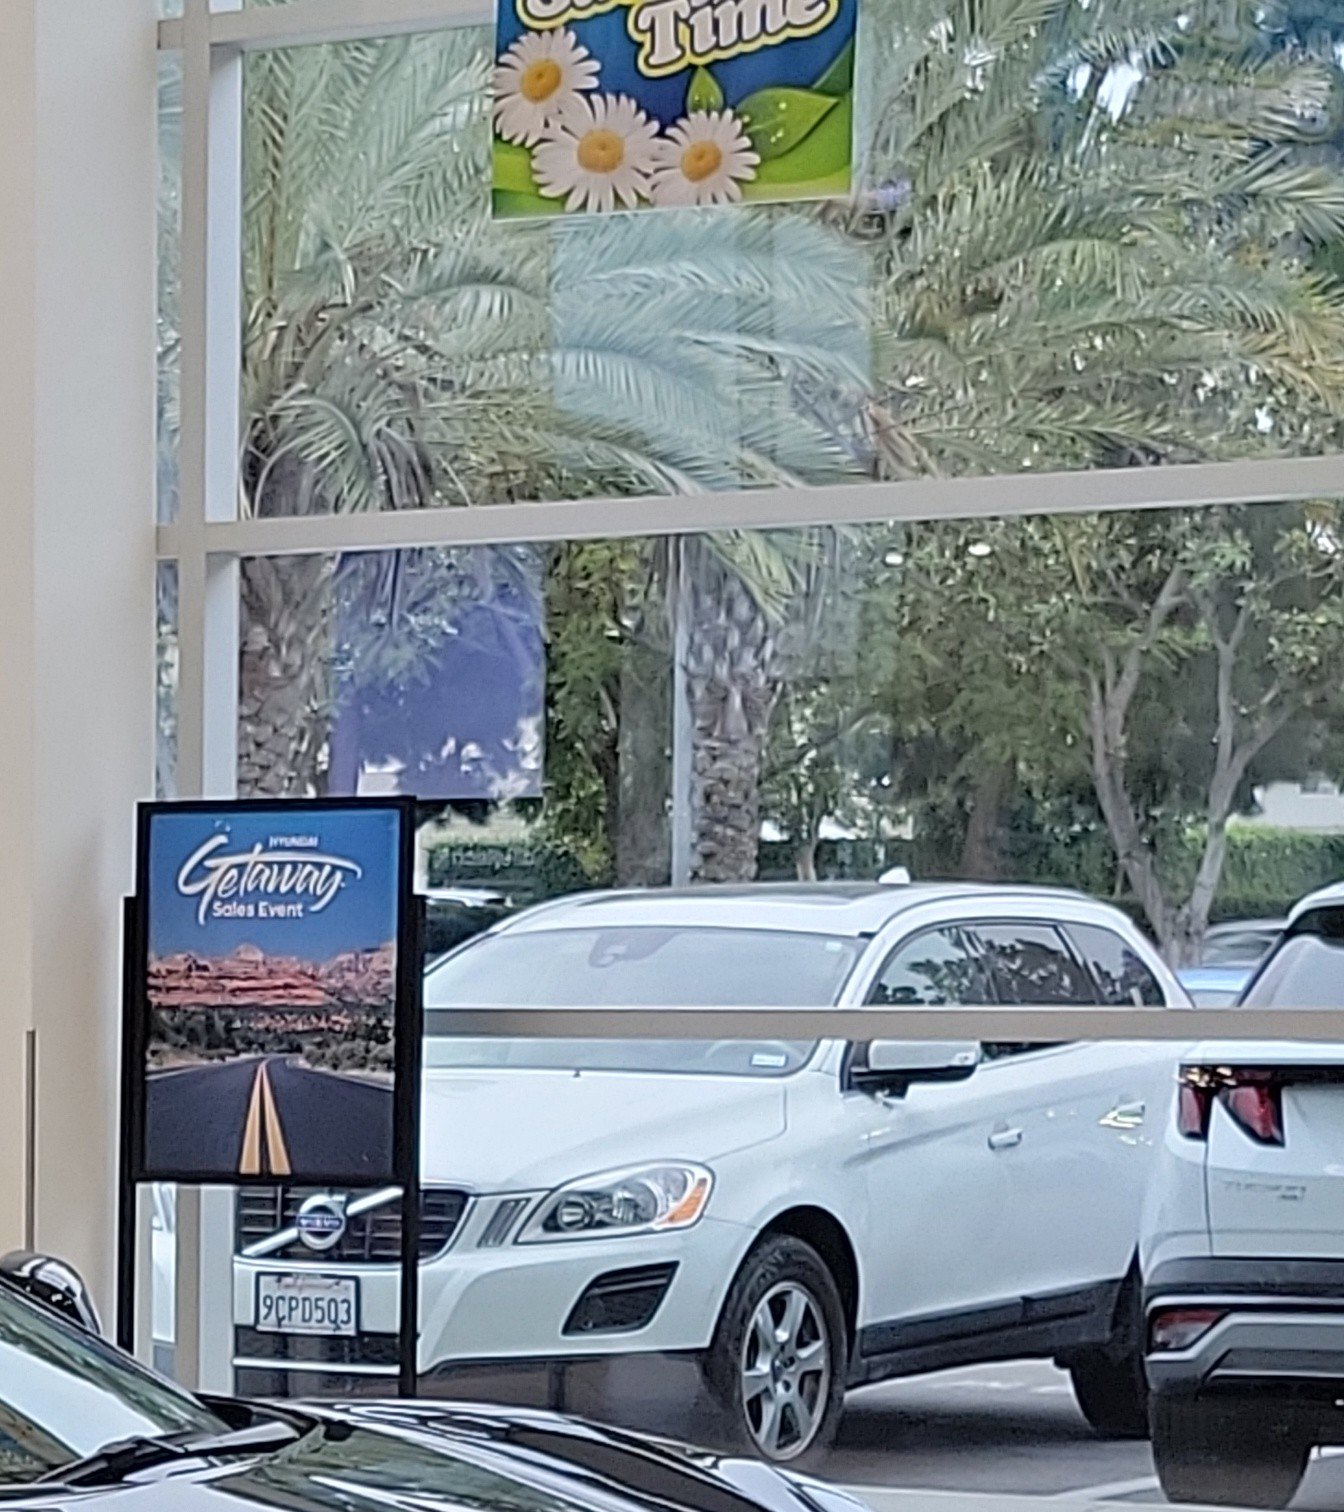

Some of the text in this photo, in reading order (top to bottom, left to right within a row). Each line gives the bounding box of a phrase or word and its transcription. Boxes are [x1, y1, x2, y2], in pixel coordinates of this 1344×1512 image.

[638, 0, 825, 65] Time
[178, 834, 362, 925] Getaway
[213, 902, 304, 918] Sales Event
